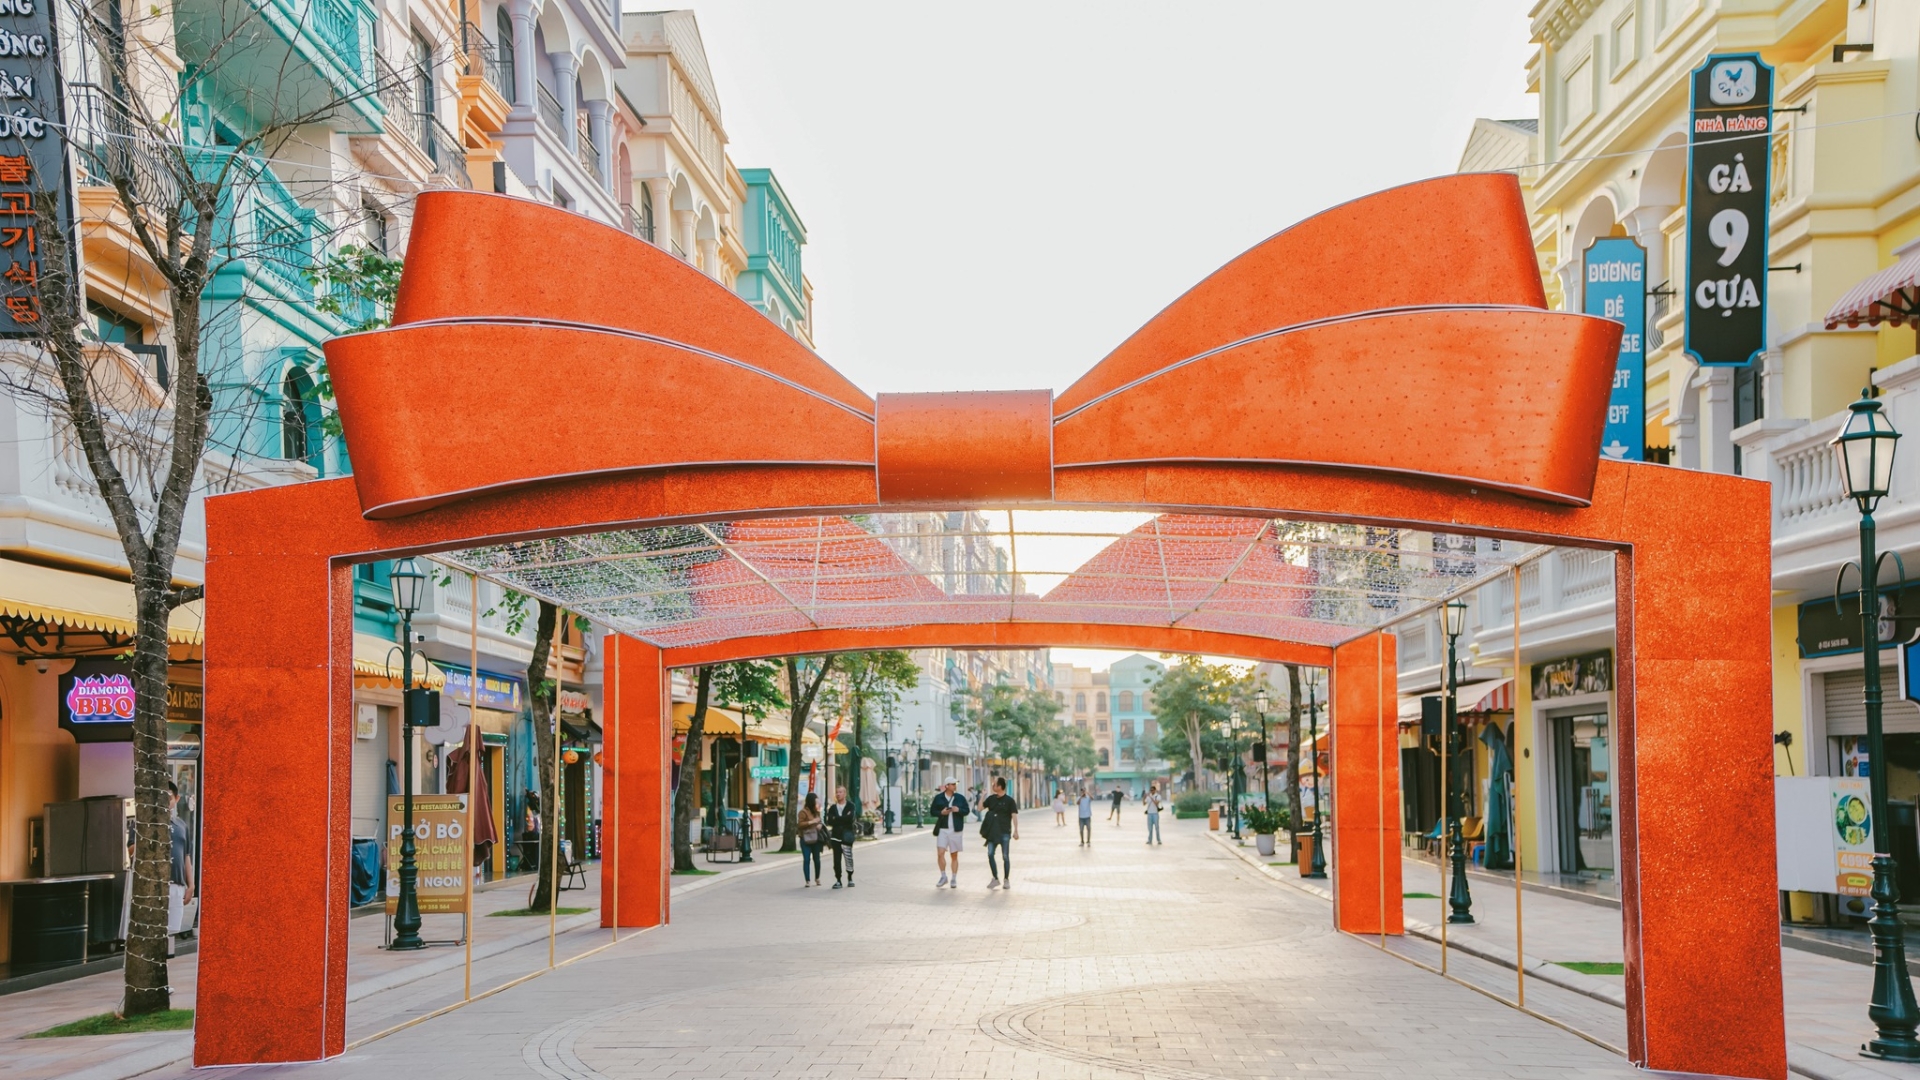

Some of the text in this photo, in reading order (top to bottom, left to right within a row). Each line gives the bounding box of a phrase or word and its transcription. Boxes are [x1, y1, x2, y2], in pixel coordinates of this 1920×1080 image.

[1695, 113, 1768, 133] NHÀ HÀNG
[1708, 208, 1749, 267] 9
[1695, 273, 1760, 317] CỰA
[78, 686, 129, 695] DIAMOND
[75, 695, 135, 719] BBQ
[391, 818, 463, 840] PỞ BÒ
[424, 876, 462, 887] NGON
